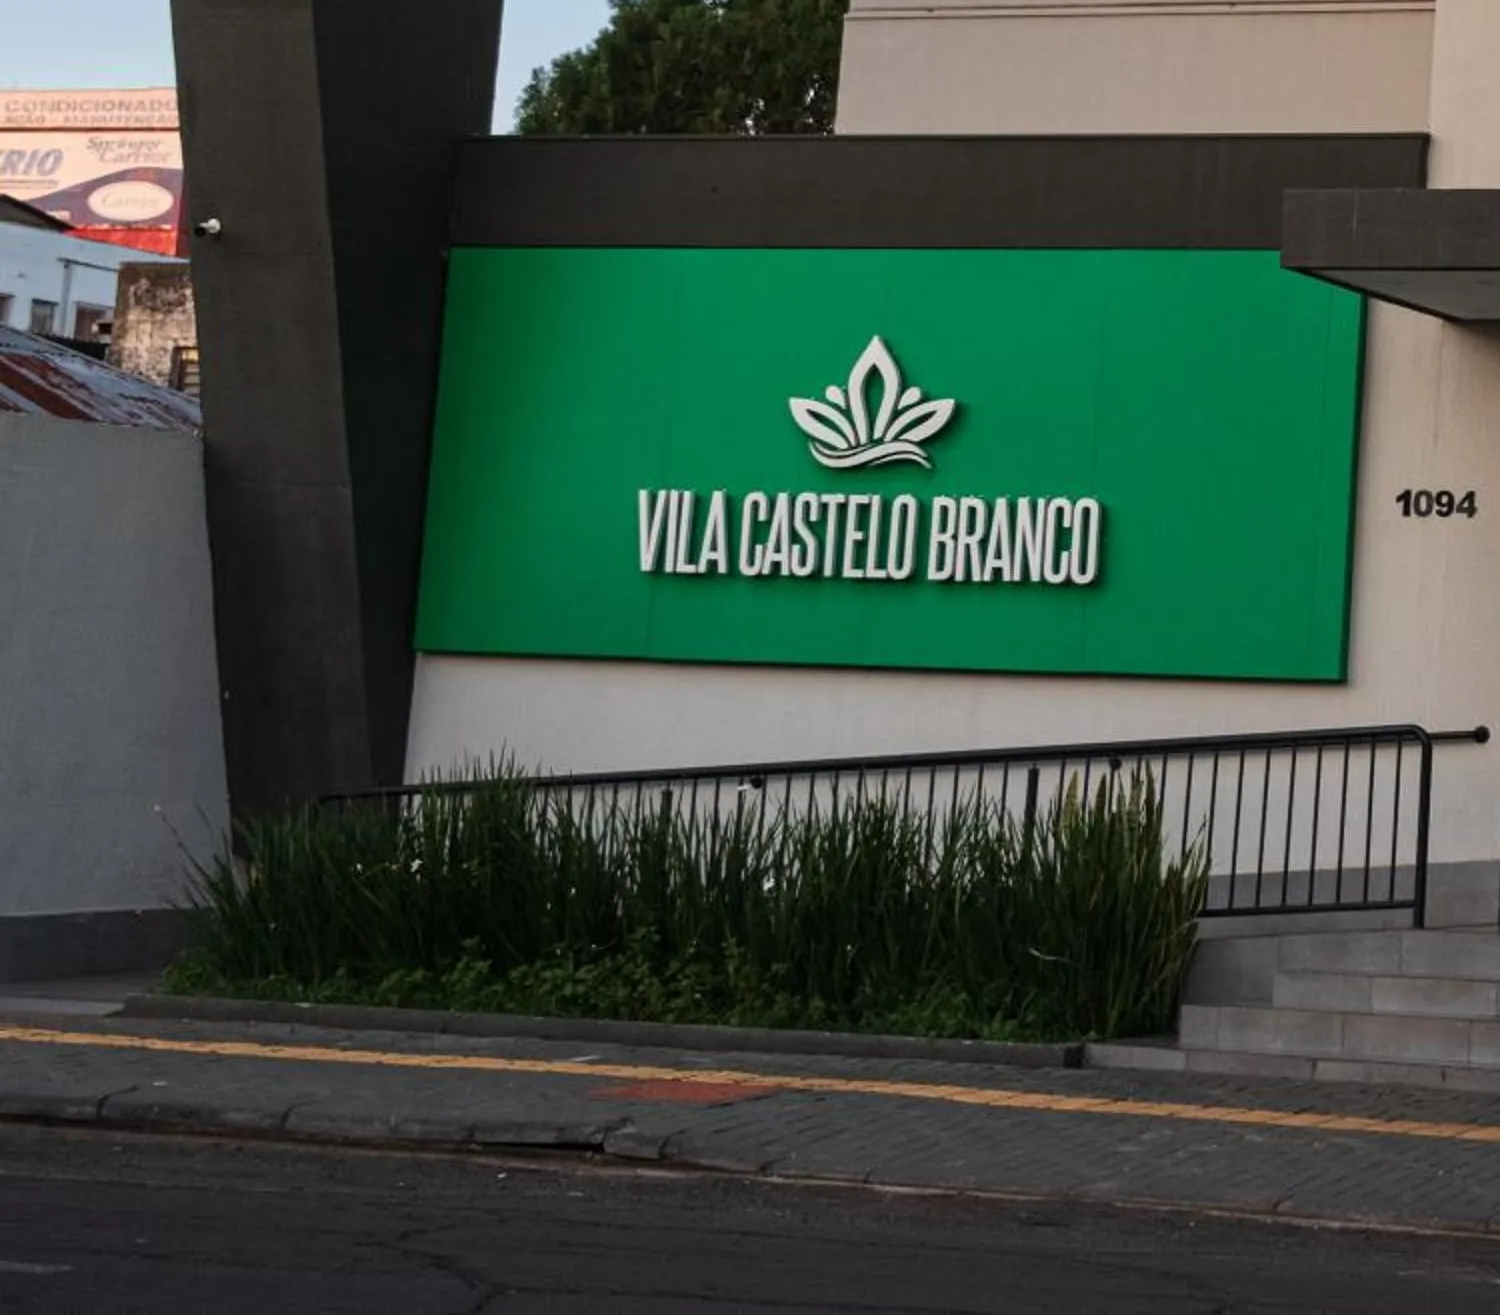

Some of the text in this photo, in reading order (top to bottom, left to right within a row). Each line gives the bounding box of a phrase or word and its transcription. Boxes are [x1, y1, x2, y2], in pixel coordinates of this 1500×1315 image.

[1395, 489, 1477, 517] 1094
[638, 489, 1099, 584] VILA CASTELO BRANCO
